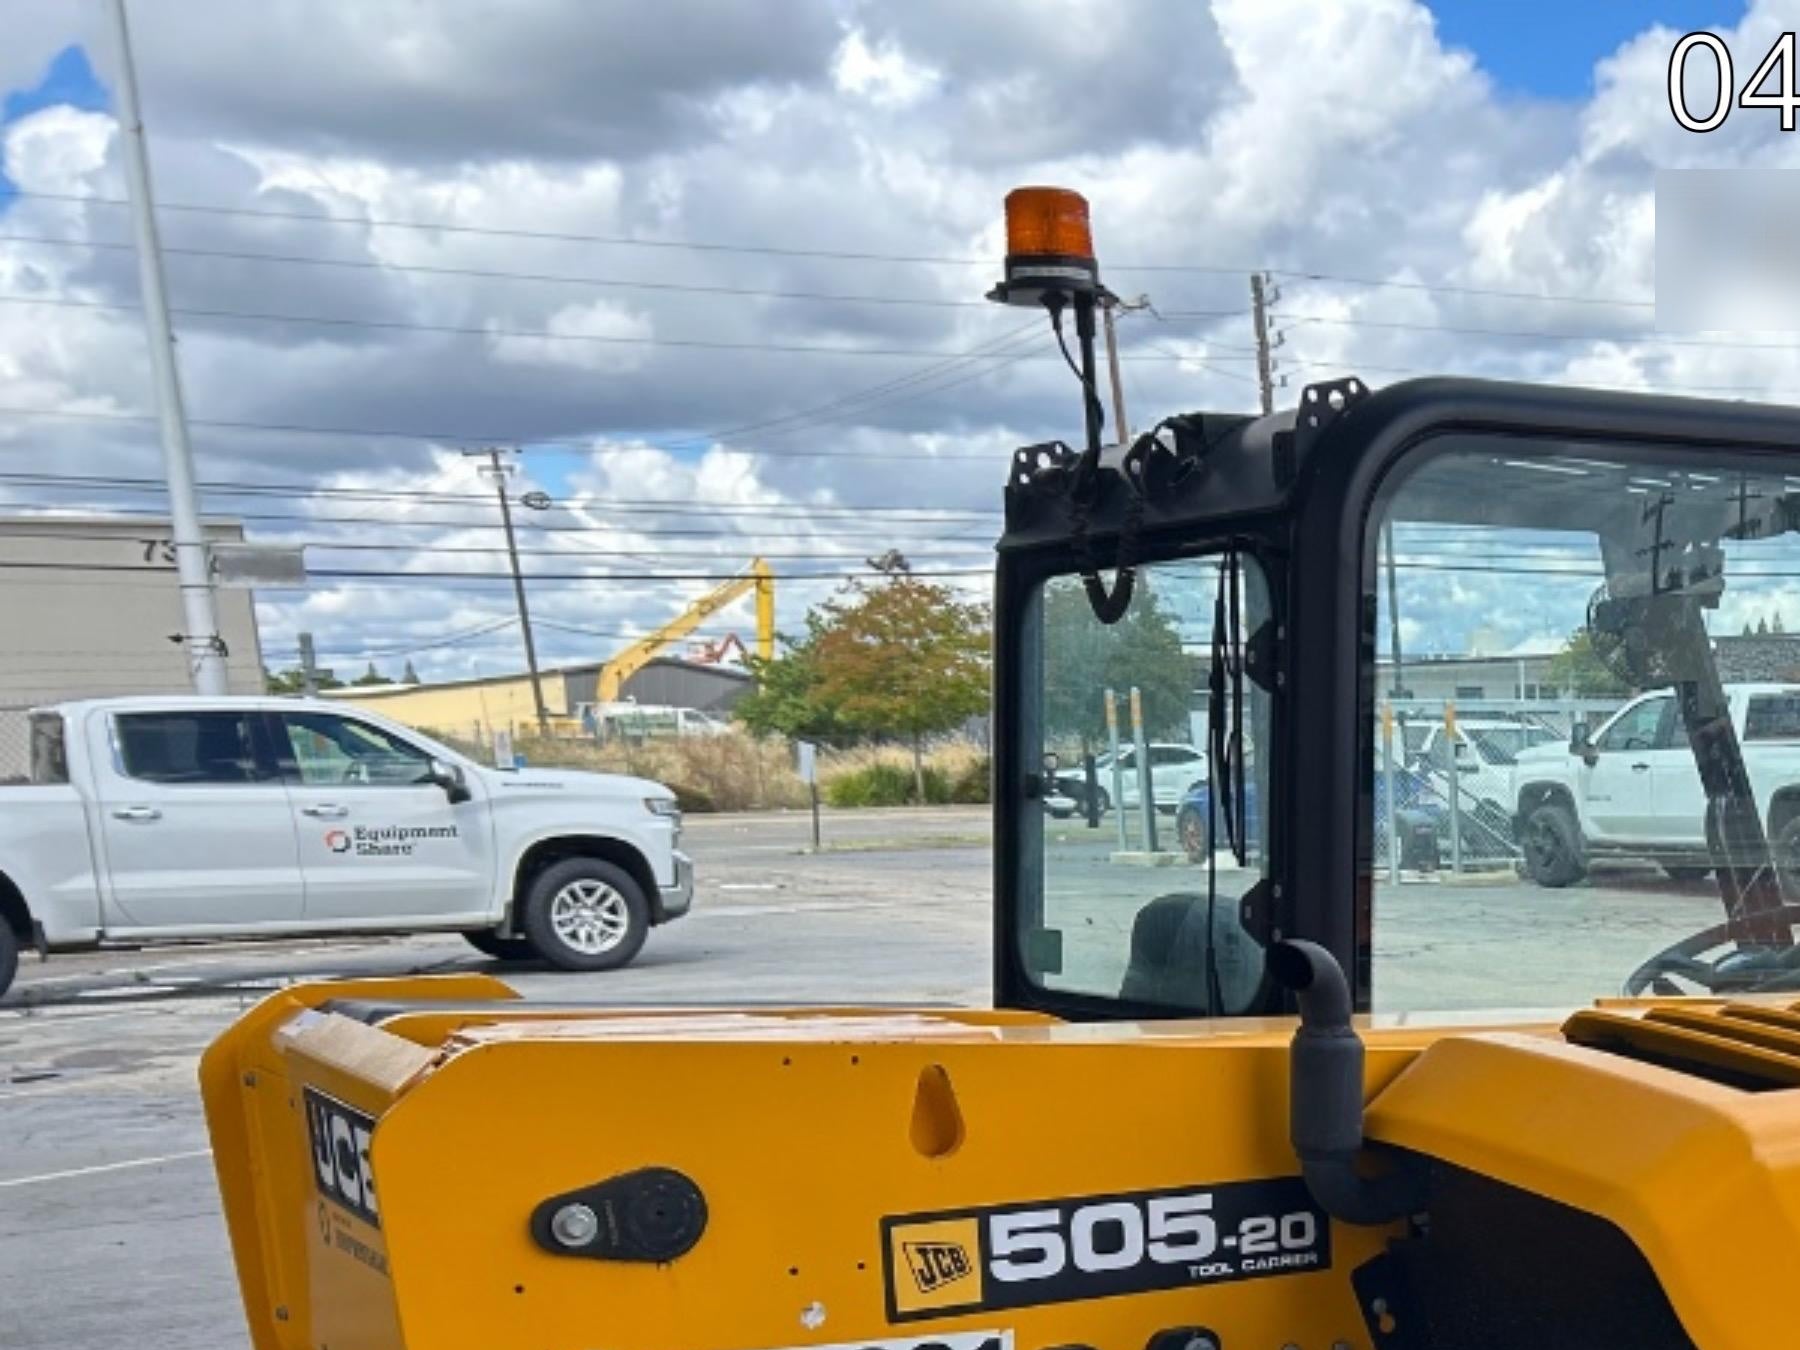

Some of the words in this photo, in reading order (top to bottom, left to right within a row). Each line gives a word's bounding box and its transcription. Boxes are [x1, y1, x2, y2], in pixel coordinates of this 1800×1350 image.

[354, 825, 458, 842] Equipment
[356, 842, 412, 855] Share
[989, 1193, 1316, 1282] 505-20
[915, 1247, 967, 1286] JCB
[1187, 1262, 1234, 1278] TOOL
[1241, 1252, 1318, 1271] CARRIER
